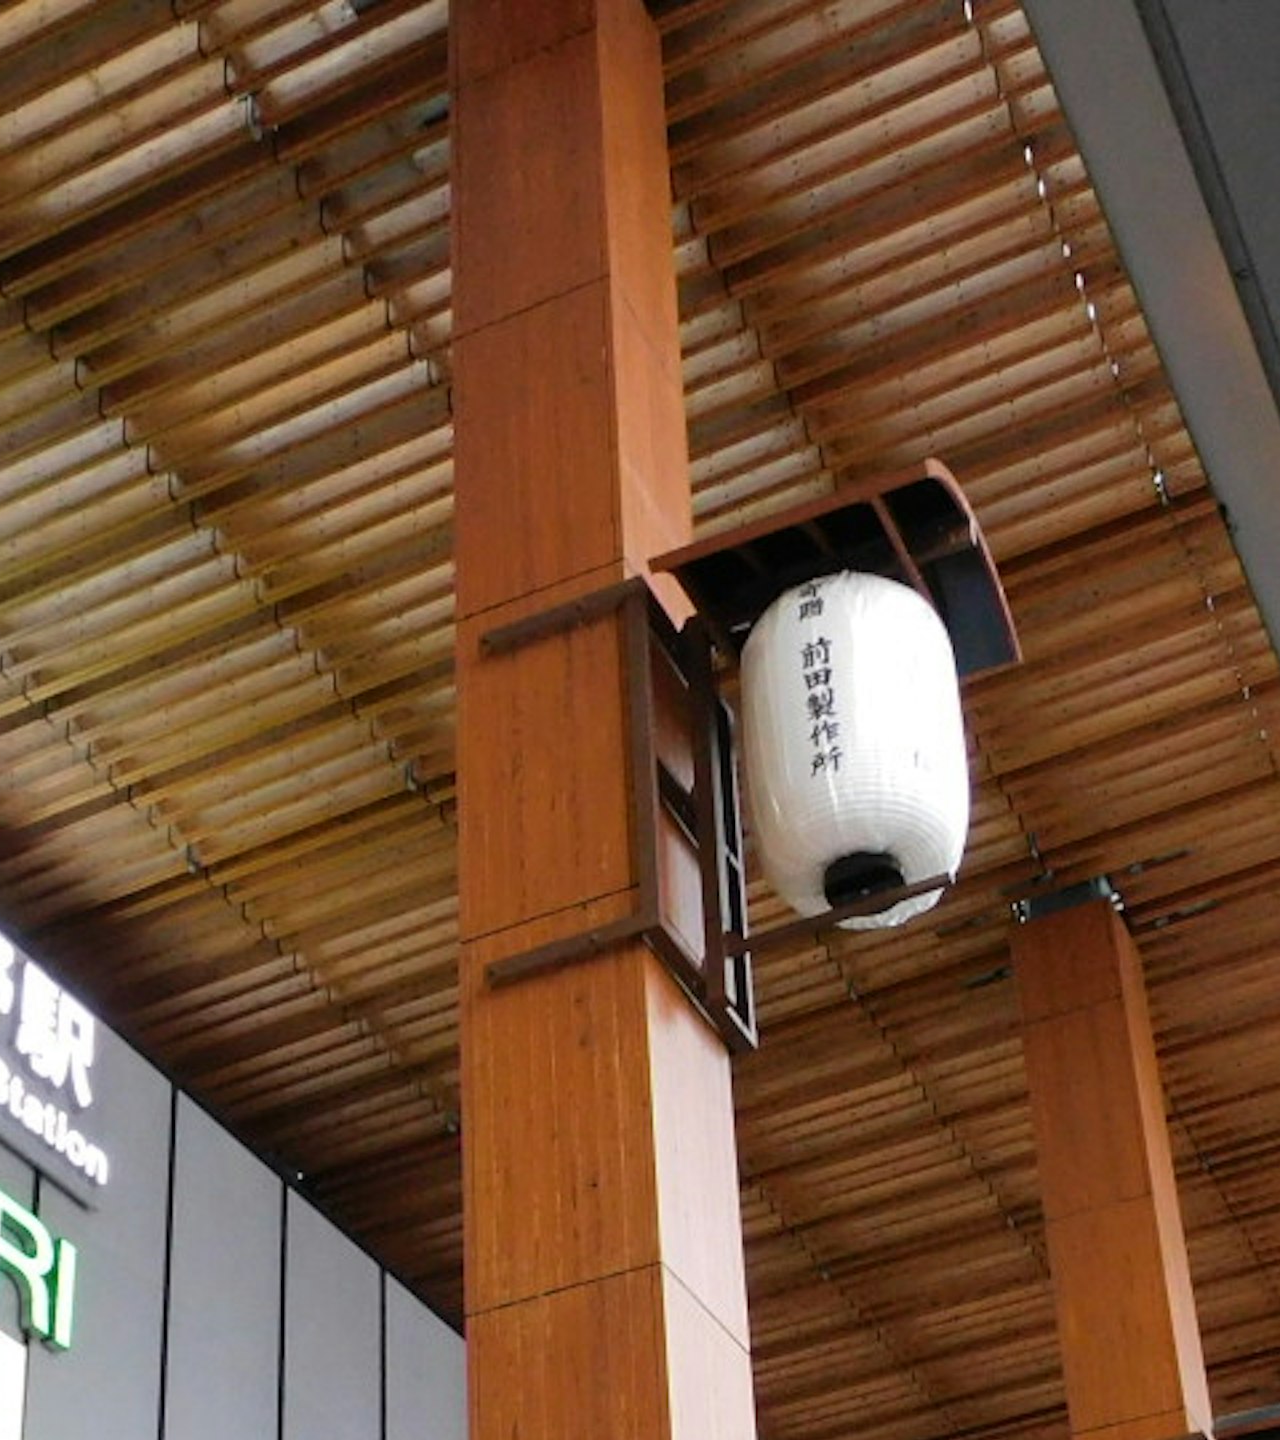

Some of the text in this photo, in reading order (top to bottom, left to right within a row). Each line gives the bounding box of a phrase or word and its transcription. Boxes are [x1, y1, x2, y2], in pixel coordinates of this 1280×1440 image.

[800, 636, 843, 777] 前田製作所
